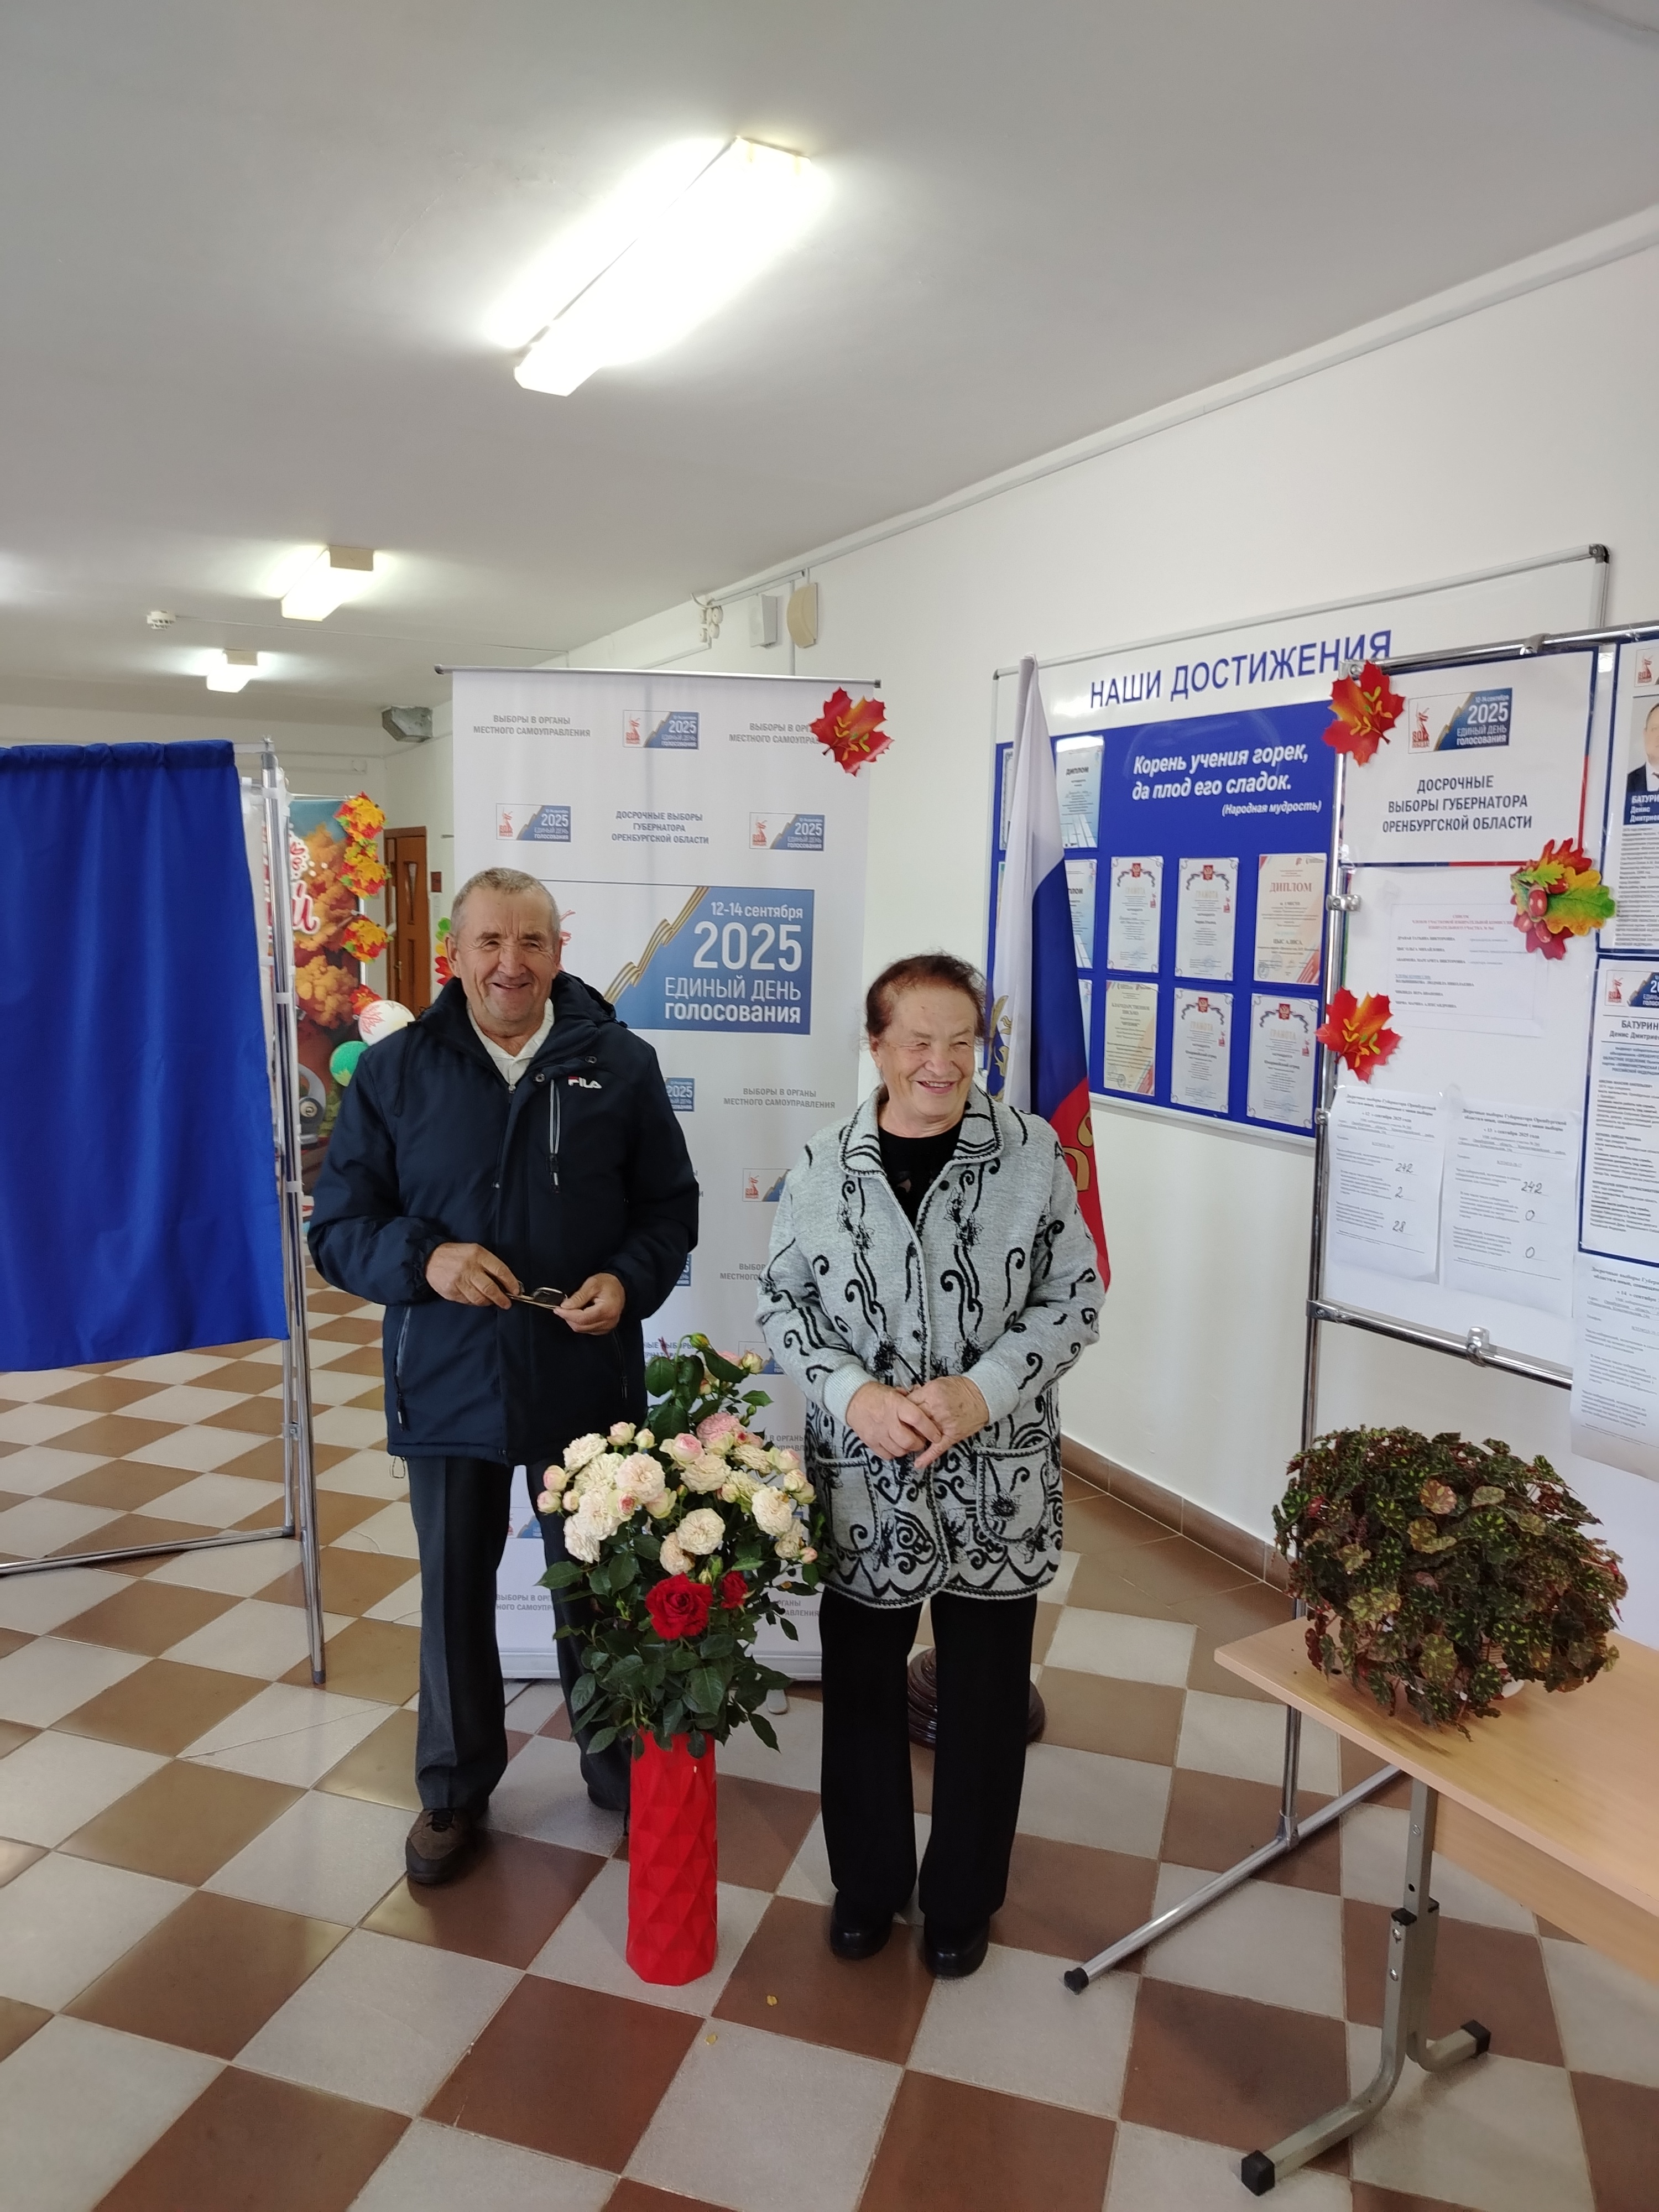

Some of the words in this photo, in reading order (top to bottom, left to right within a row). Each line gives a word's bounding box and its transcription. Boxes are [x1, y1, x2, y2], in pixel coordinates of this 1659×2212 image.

[1091, 669, 1161, 708] НАШИ
[1170, 629, 1391, 701] ДОСТИЖЕНИЯ
[1467, 701, 1509, 724] 2025
[493, 715, 529, 724] ВЫБОРЫ
[539, 716, 570, 725] ОРГАНЫ
[473, 726, 515, 735] МЕСТНОГО
[516, 727, 591, 738] САМОУПРАВЛЕНИЯ
[668, 721, 697, 734] 2025
[749, 723, 785, 732] ВЫБОРЫ
[1457, 724, 1486, 737] ЕДИНЫЙ
[1488, 724, 1507, 735] ДЕНЬ
[729, 734, 770, 743] МЕСТНОГО
[772, 735, 817, 744] САМОУПРА
[1134, 755, 1186, 778] Корень
[1190, 753, 1248, 779] учения
[1253, 743, 1310, 766] горек,
[1132, 781, 1150, 800] да
[1152, 778, 1190, 797] плод
[1194, 779, 1222, 799] его
[1225, 770, 1292, 794] сладок.
[1417, 775, 1494, 794] ДОСРОЧНЫЕ
[1388, 796, 1438, 813] ВЫБОРЫ
[1442, 794, 1528, 812] ГУБЕРНАТОРА
[1631, 794, 1659, 804] БАТУРИ
[1221, 803, 1267, 817] (Народная
[1269, 800, 1322, 816] мудрость)
[541, 814, 569, 827] 2025
[615, 811, 666, 821] ДОСРОЧНЫЕ
[667, 813, 703, 821] ВЫБОРЫ
[633, 823, 686, 833] ГУБЕРНАТОРА
[794, 823, 823, 836] 2025
[1382, 814, 1469, 833] ОРЕНБУРГСКОЙ
[1473, 815, 1532, 831] ОБЛАСТИ
[612, 832, 671, 843] ОРЕНБУРГСКОЙ
[673, 836, 709, 845] ОБЛАСТИ
[1269, 882, 1313, 893] ДИПЛОМ
[711, 901, 743, 916] 12-14
[744, 904, 804, 922] сентября
[693, 920, 803, 972] 2025
[664, 975, 746, 1000] ЕДИНЫЙ
[750, 979, 802, 1002] ДЕНЬ
[664, 1002, 802, 1024] голосования
[1609, 1030, 1629, 1039] Денис
[1630, 1032, 1659, 1041] Дмитрие
[567, 1076, 602, 1089] FILA
[666, 1084, 693, 1098] 2025
[787, 1089, 817, 1098] ОРГАНЫ
[723, 1098, 763, 1106] МЕСТНОГО
[765, 1098, 836, 1109] САМОУПРАВЛЕНИЯ
[1394, 1186, 1403, 1198] 2
[1521, 1181, 1543, 1194] 242
[1392, 1220, 1406, 1232] 28
[739, 1263, 765, 1271] ВЫБОР
[720, 1272, 758, 1281] МЕСТНОГО
[1641, 1277, 1659, 1286] Губерн
